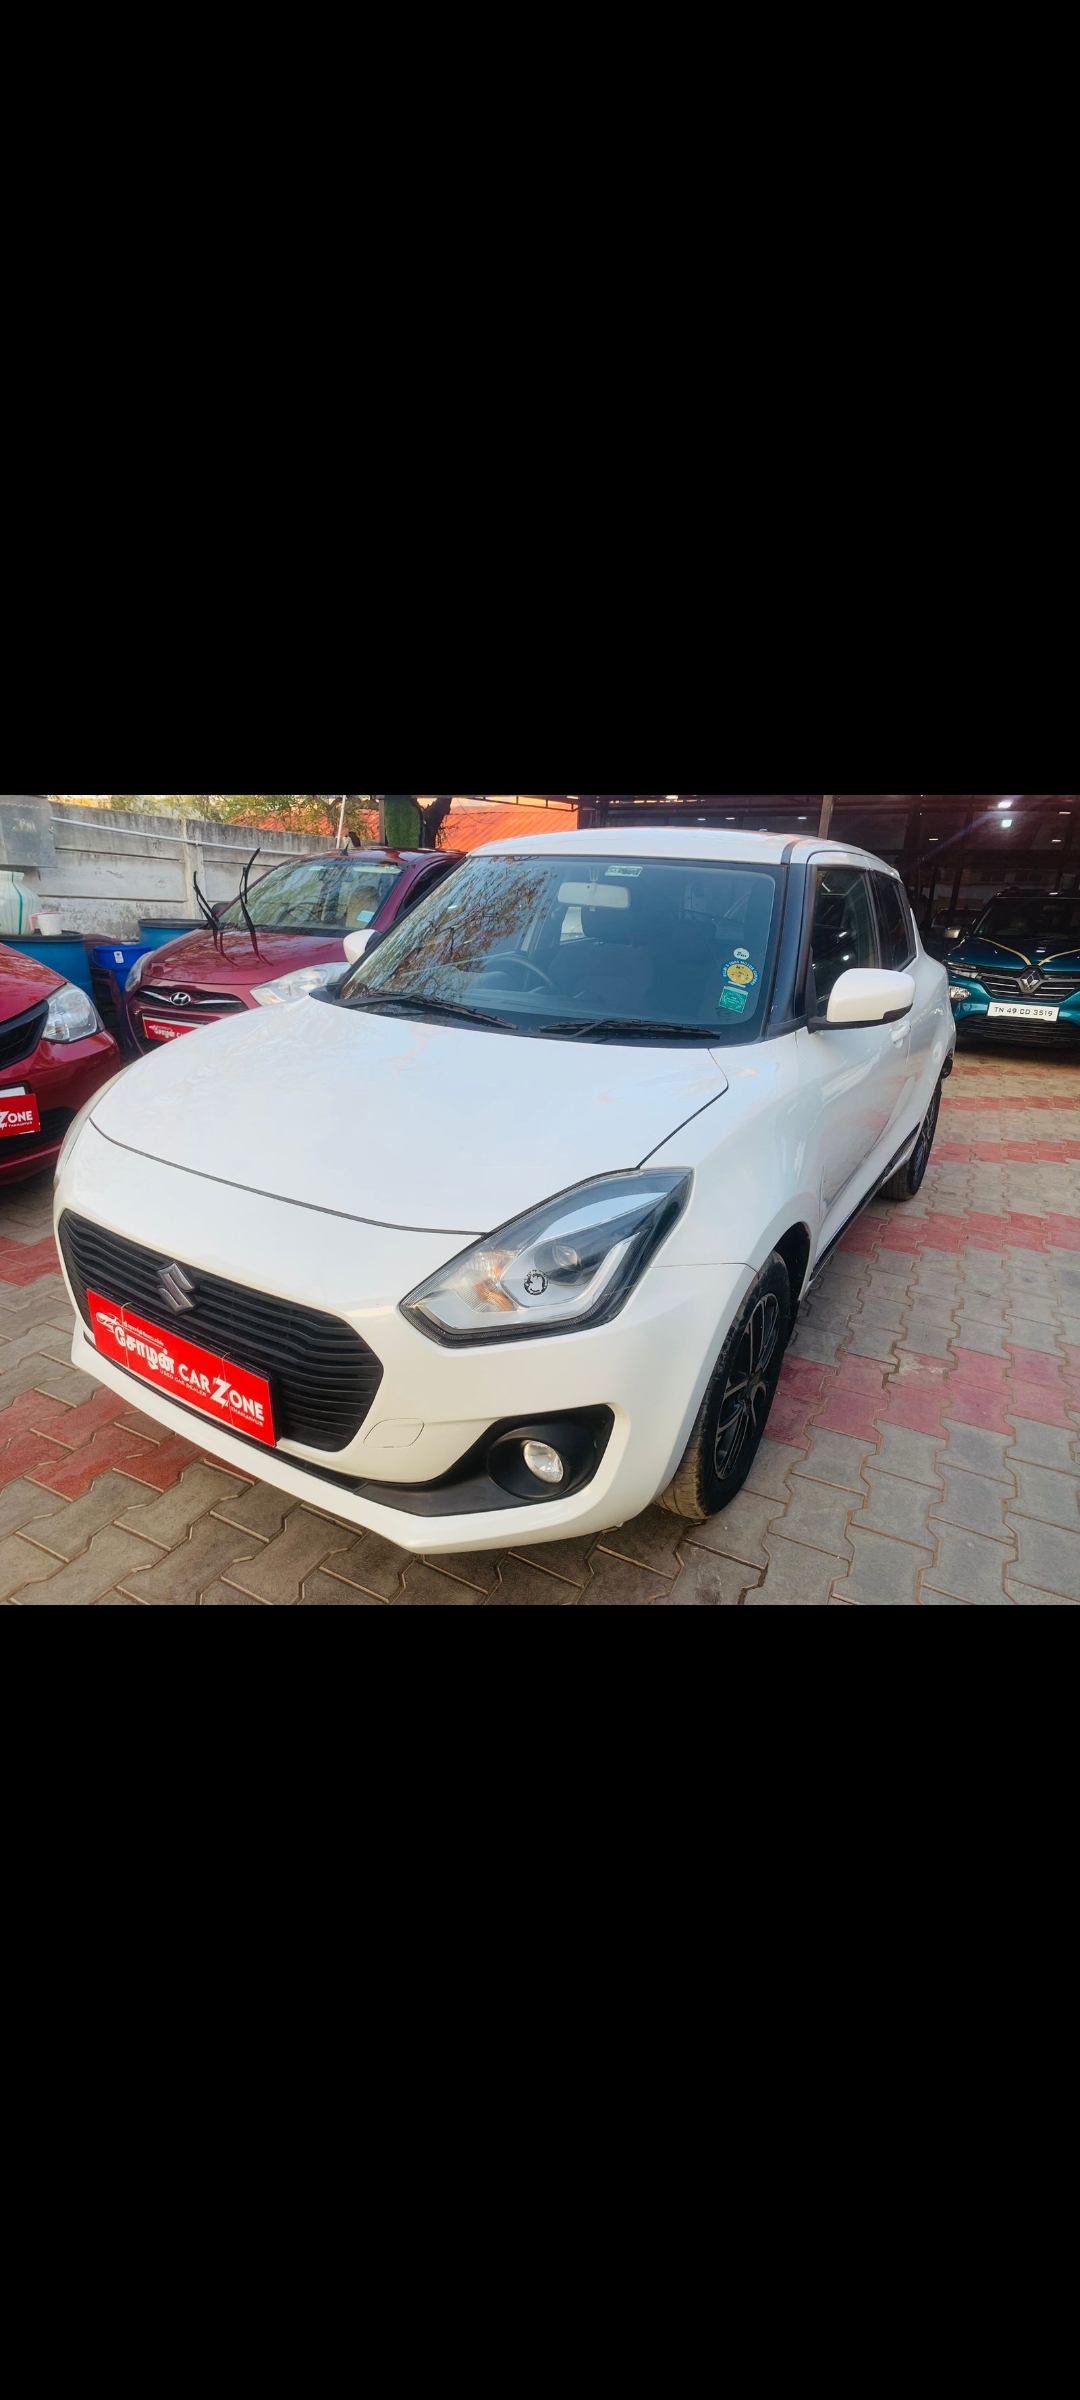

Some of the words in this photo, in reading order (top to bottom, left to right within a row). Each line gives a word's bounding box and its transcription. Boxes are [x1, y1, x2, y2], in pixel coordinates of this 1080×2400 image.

[160, 1369, 174, 1380] USED
[174, 1377, 185, 1386] CAR
[186, 1384, 207, 1397] DEALER
[179, 1364, 211, 1393] CAR
[210, 1374, 265, 1421] ZONE
